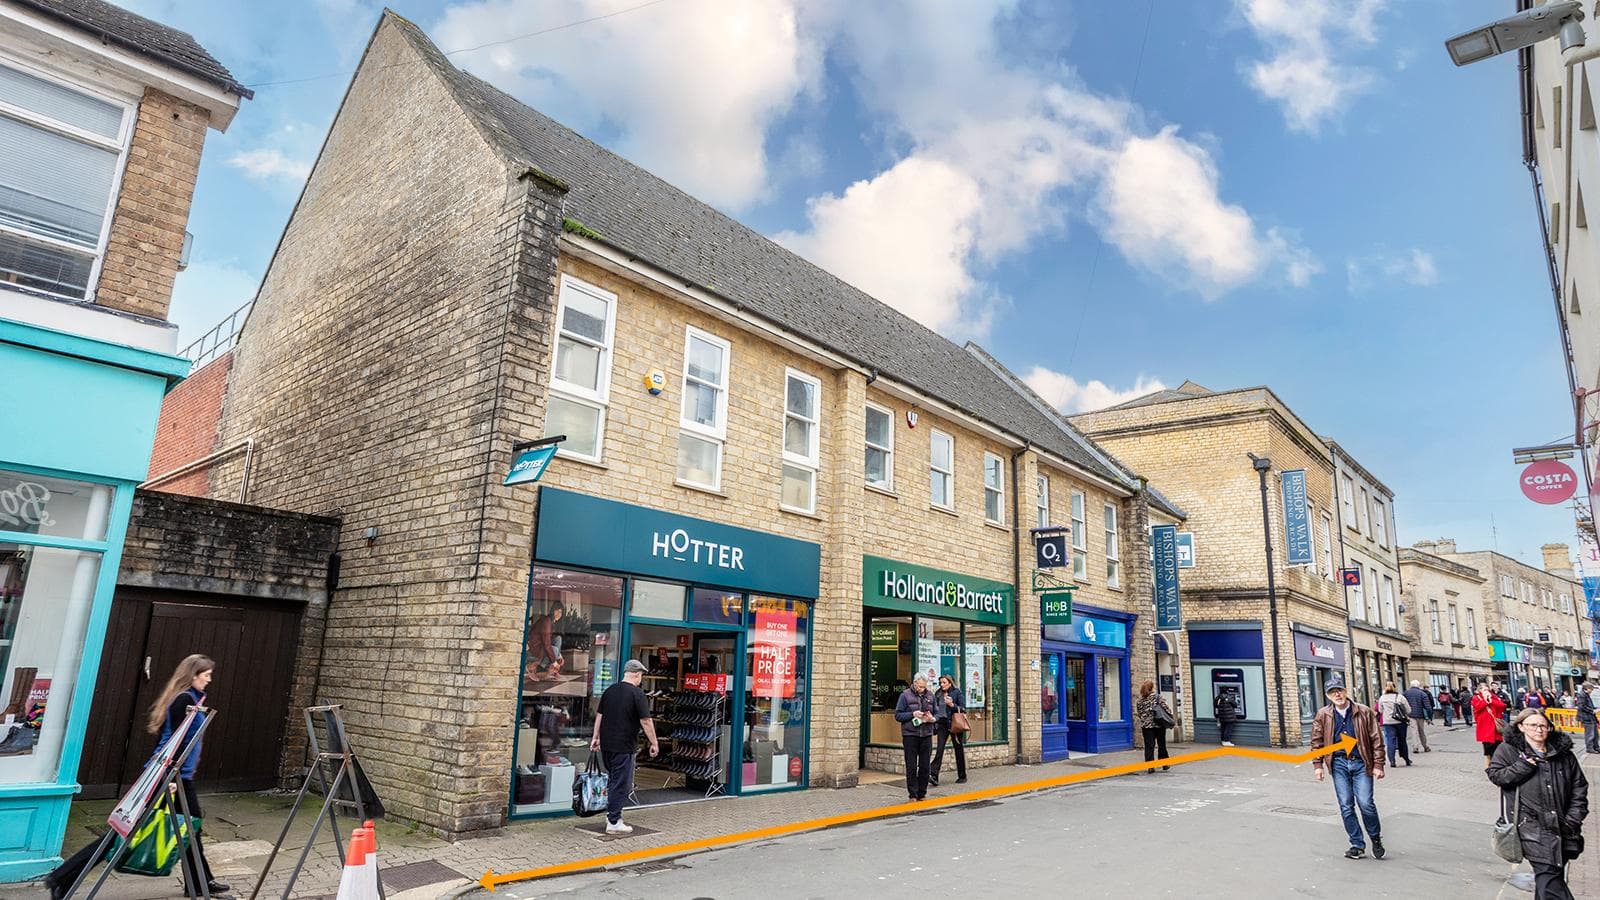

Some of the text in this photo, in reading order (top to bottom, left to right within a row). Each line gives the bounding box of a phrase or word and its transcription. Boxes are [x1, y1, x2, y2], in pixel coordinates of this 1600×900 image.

[1524, 473, 1572, 485] COSTA
[1292, 475, 1308, 557] BISHOPS WALK
[652, 528, 745, 571] HOTTER
[1162, 531, 1177, 622] BISHOPS WALK
[884, 570, 945, 605] Holland
[957, 583, 1003, 613] Barrett
[760, 645, 791, 660] HALF
[685, 678, 699, 686] SALE
[758, 660, 792, 675] PRICE
